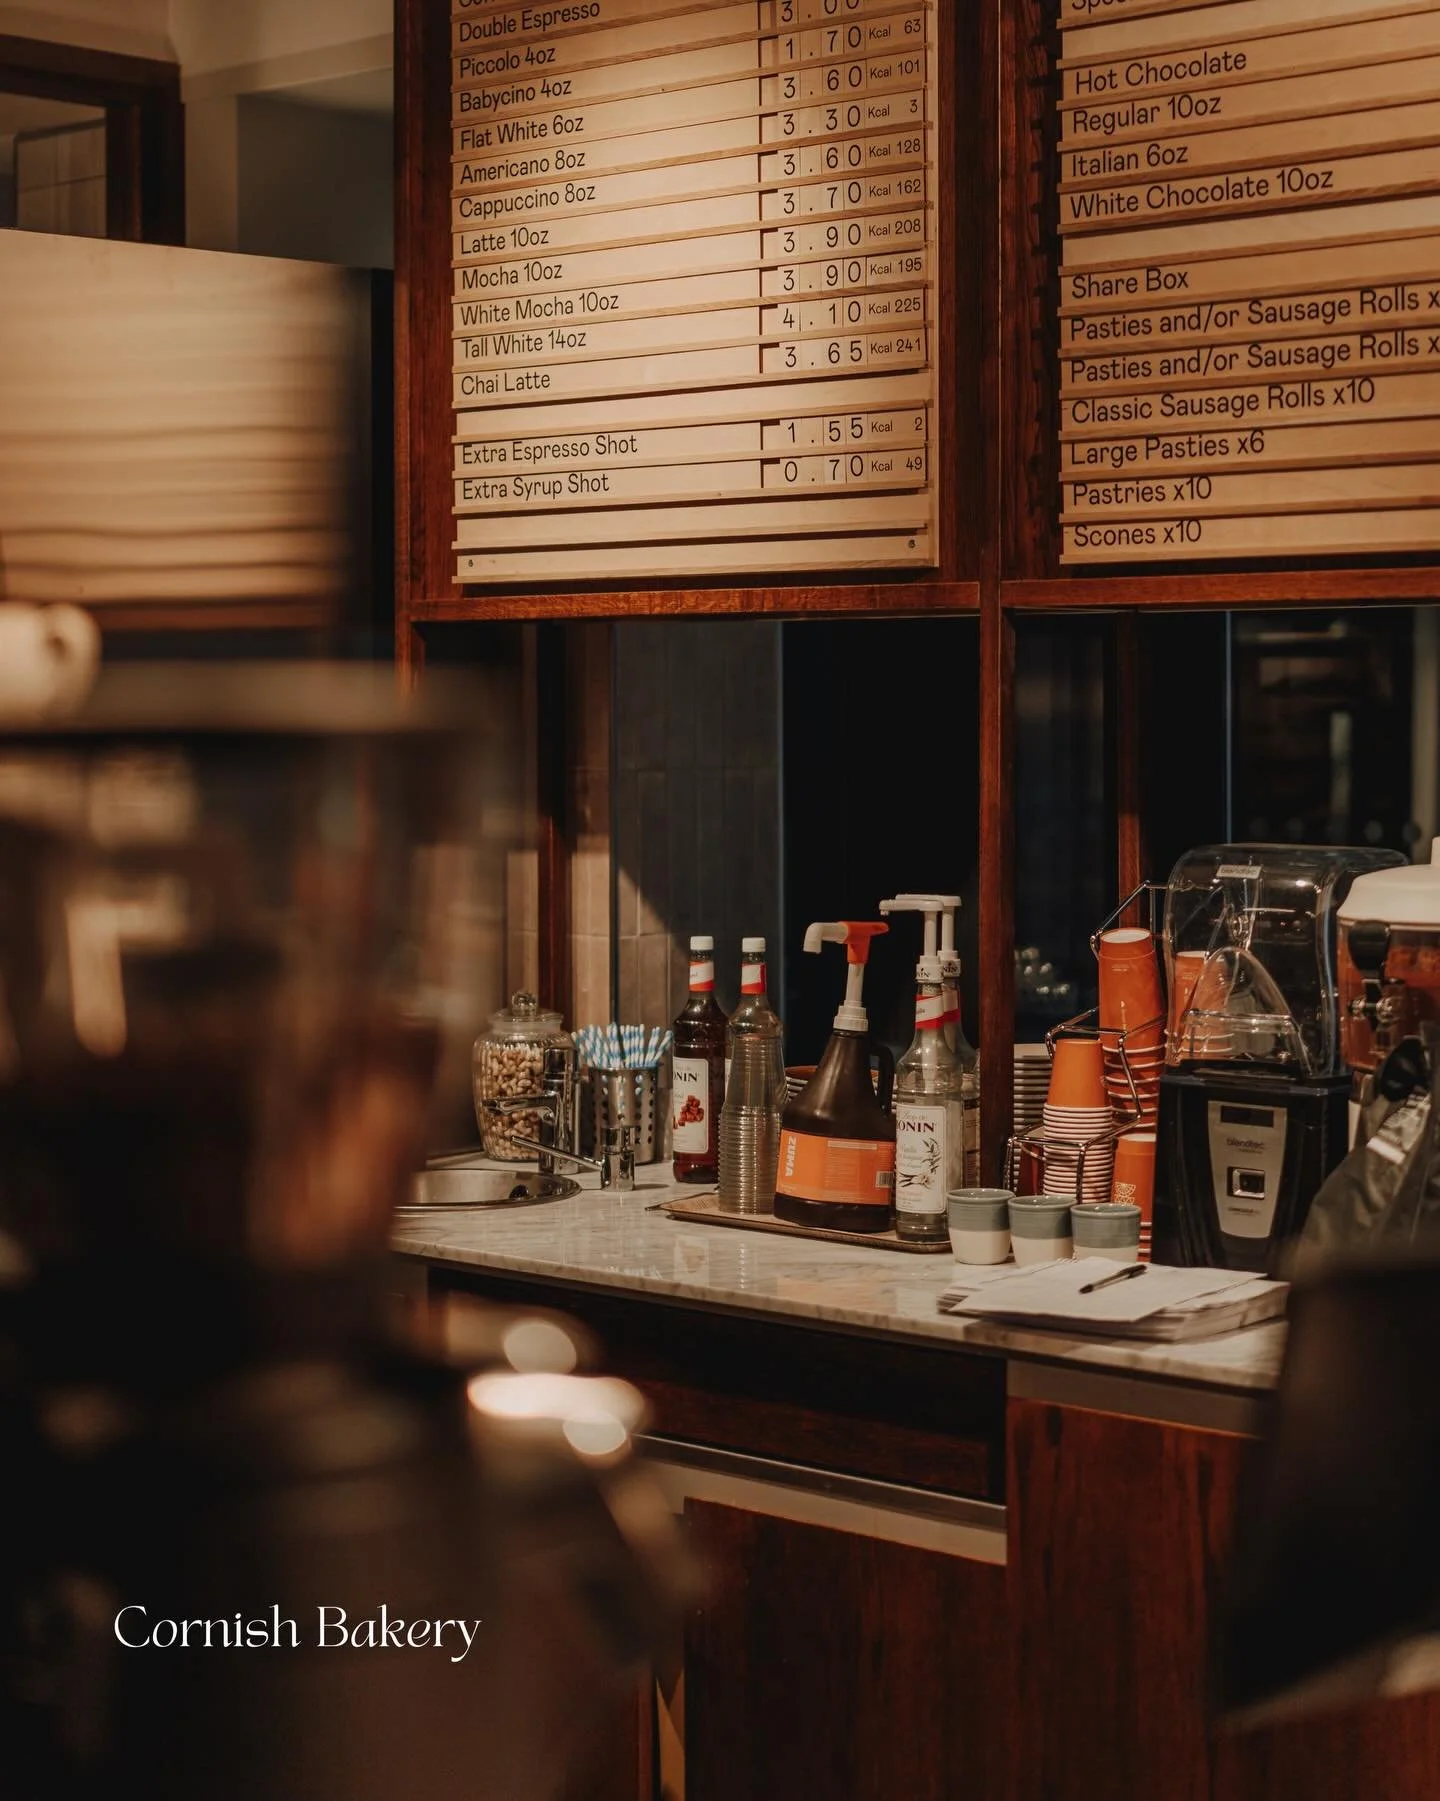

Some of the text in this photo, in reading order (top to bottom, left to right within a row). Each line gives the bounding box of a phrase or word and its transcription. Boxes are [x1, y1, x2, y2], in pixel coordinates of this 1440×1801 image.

[459, 3, 600, 42] Double Espresso
[869, 28, 891, 39] Kcal
[904, 19, 921, 34] 63
[460, 47, 556, 78] Piccolo 4oz
[870, 66, 892, 79] Kcal
[897, 60, 920, 76] 101
[1075, 51, 1247, 94] Hot Chocolate
[460, 80, 572, 112] Babycino 4oz
[868, 106, 890, 118] Kcal
[910, 100, 918, 113] 3
[1072, 94, 1221, 135] Regular 10oz
[461, 115, 583, 150] Flat White 6oz
[869, 144, 891, 157] Kcal
[897, 138, 920, 153] 128
[460, 150, 585, 184] Americano 8oz
[1072, 144, 1188, 177] Italian 6oz
[459, 183, 596, 220] Cappuccino 8oz
[869, 184, 891, 197] Kcal
[897, 179, 921, 194] 162
[1070, 168, 1333, 219] White Chocolate 10oz
[461, 227, 549, 255] Latte 10oz
[868, 224, 891, 237] Kcal
[894, 219, 921, 234] 208
[462, 261, 562, 289] Mocha 10oz
[870, 262, 892, 275] Kcal
[898, 258, 922, 272] 195
[1072, 268, 1189, 299] Share Box
[461, 292, 619, 326] White Mocha 10oz
[868, 301, 890, 314] Kcal
[894, 297, 921, 312] 225
[1071, 316, 1152, 341] Pasties
[1159, 302, 1239, 333] and/or
[1248, 299, 1351, 325] Sausage
[1359, 285, 1419, 314] Rolls
[461, 329, 586, 358] Tall White 14oz
[870, 341, 892, 354] Kcal
[896, 338, 921, 353] 241
[1071, 358, 1152, 383] Pasties
[1159, 346, 1239, 376] and/or
[1248, 344, 1351, 369] Sausage
[1359, 331, 1419, 359] Rolls
[461, 372, 550, 395] Chai Latte
[1072, 377, 1375, 424] Classic Sausage Rolls x10
[871, 420, 893, 432] Kcal
[914, 417, 923, 431] 2
[462, 434, 637, 464] Extra Espresso Shot
[1071, 429, 1265, 468] Large Pasties x6
[871, 459, 893, 472] Kcal
[906, 456, 922, 471] 49
[462, 473, 609, 500] Extra Syrup Shot
[1072, 475, 1212, 506] Pastries x10
[1073, 519, 1202, 548] Scones x10
[897, 1121, 935, 1133] ONIN
[785, 1136, 797, 1177] ZUMA
